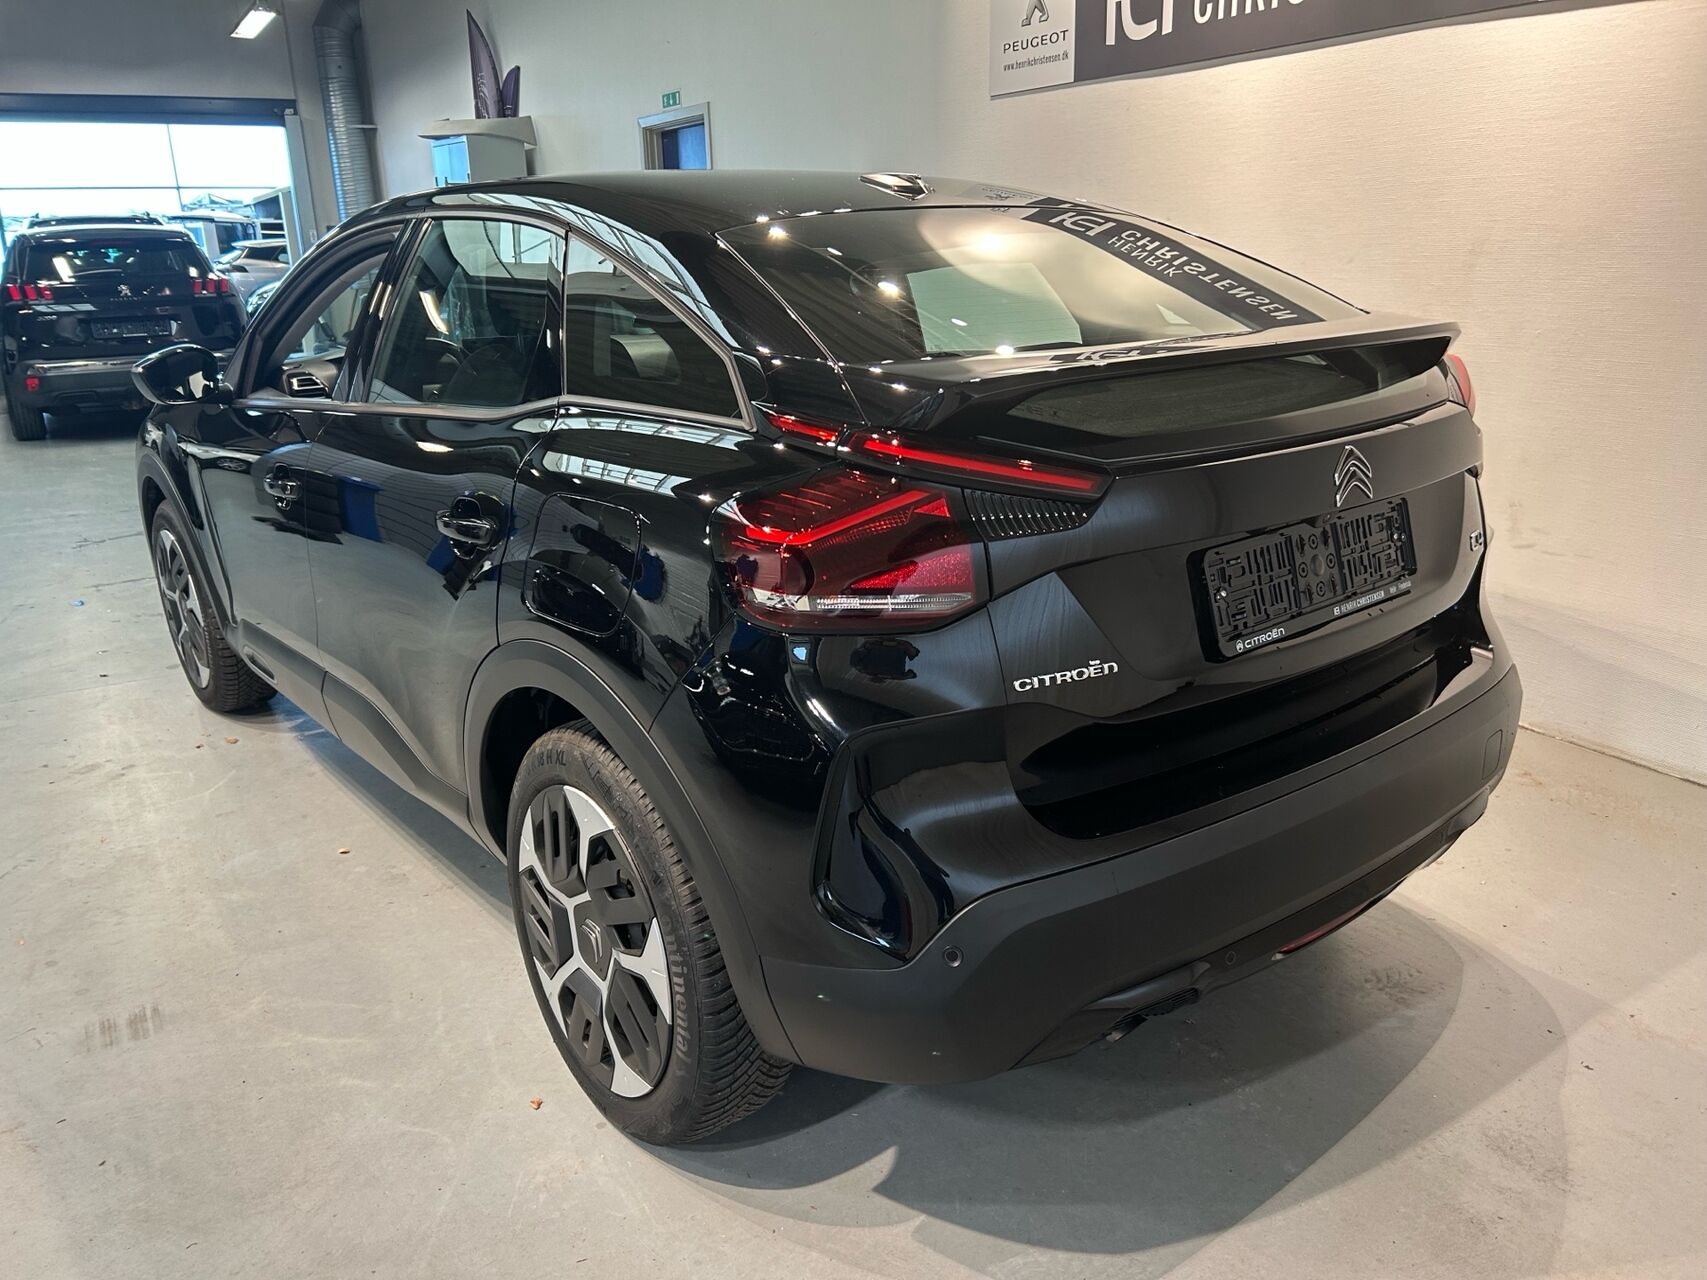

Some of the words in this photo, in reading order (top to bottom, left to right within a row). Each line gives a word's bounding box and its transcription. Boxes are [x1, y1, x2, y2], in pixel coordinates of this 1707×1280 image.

[1003, 29, 1069, 54] PEUGEOT
[1003, 50, 1069, 72] www.henrikchristensen.dk
[659, 908, 692, 1065] ontinental
